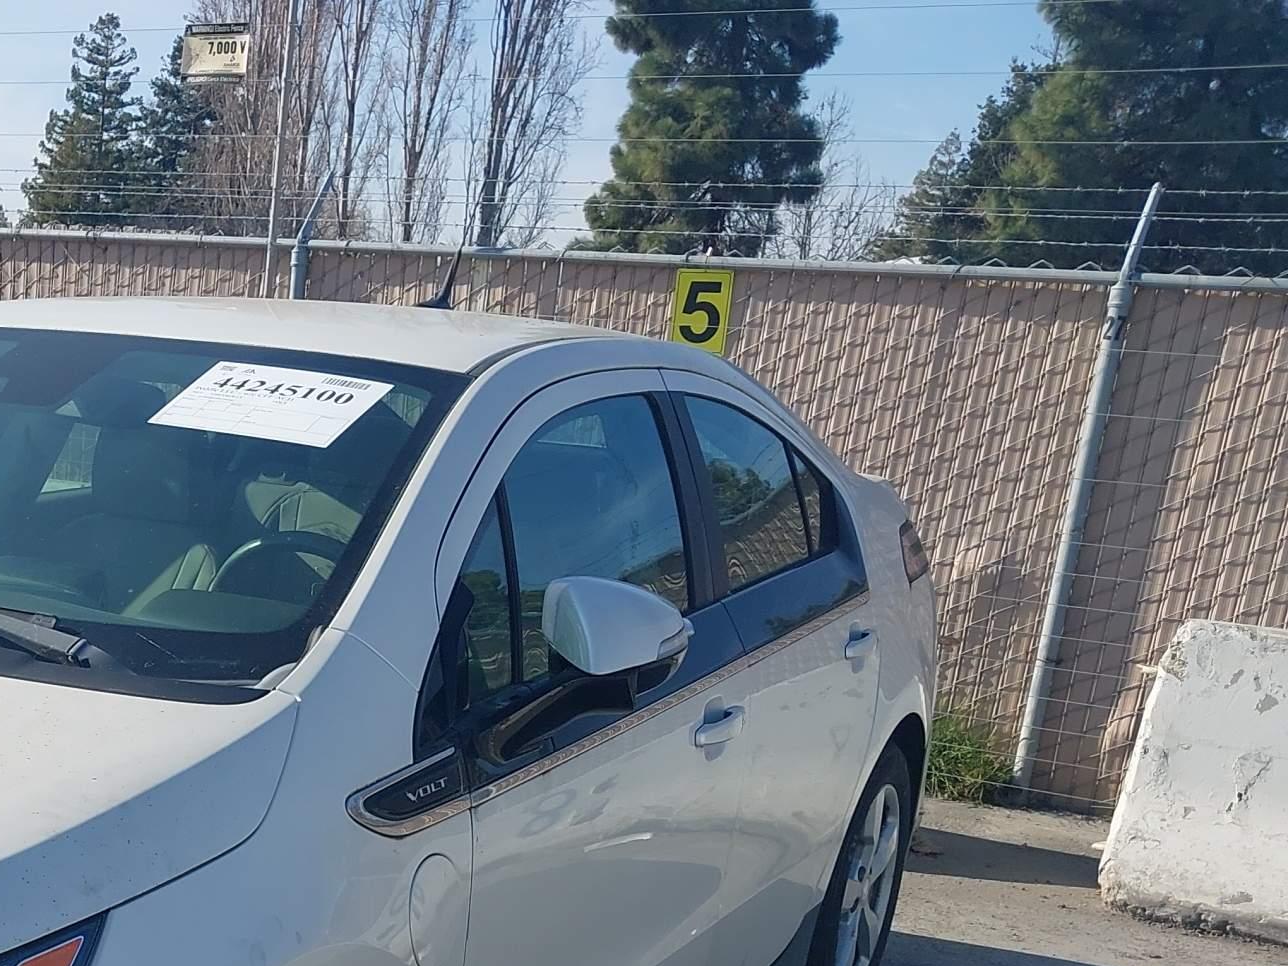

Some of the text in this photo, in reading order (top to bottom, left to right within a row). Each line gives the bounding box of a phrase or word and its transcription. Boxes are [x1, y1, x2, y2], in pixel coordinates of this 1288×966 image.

[208, 40, 247, 56] 7,000 V
[679, 281, 722, 343] 5
[213, 376, 354, 405] 44245100
[405, 777, 448, 802] VOLT
